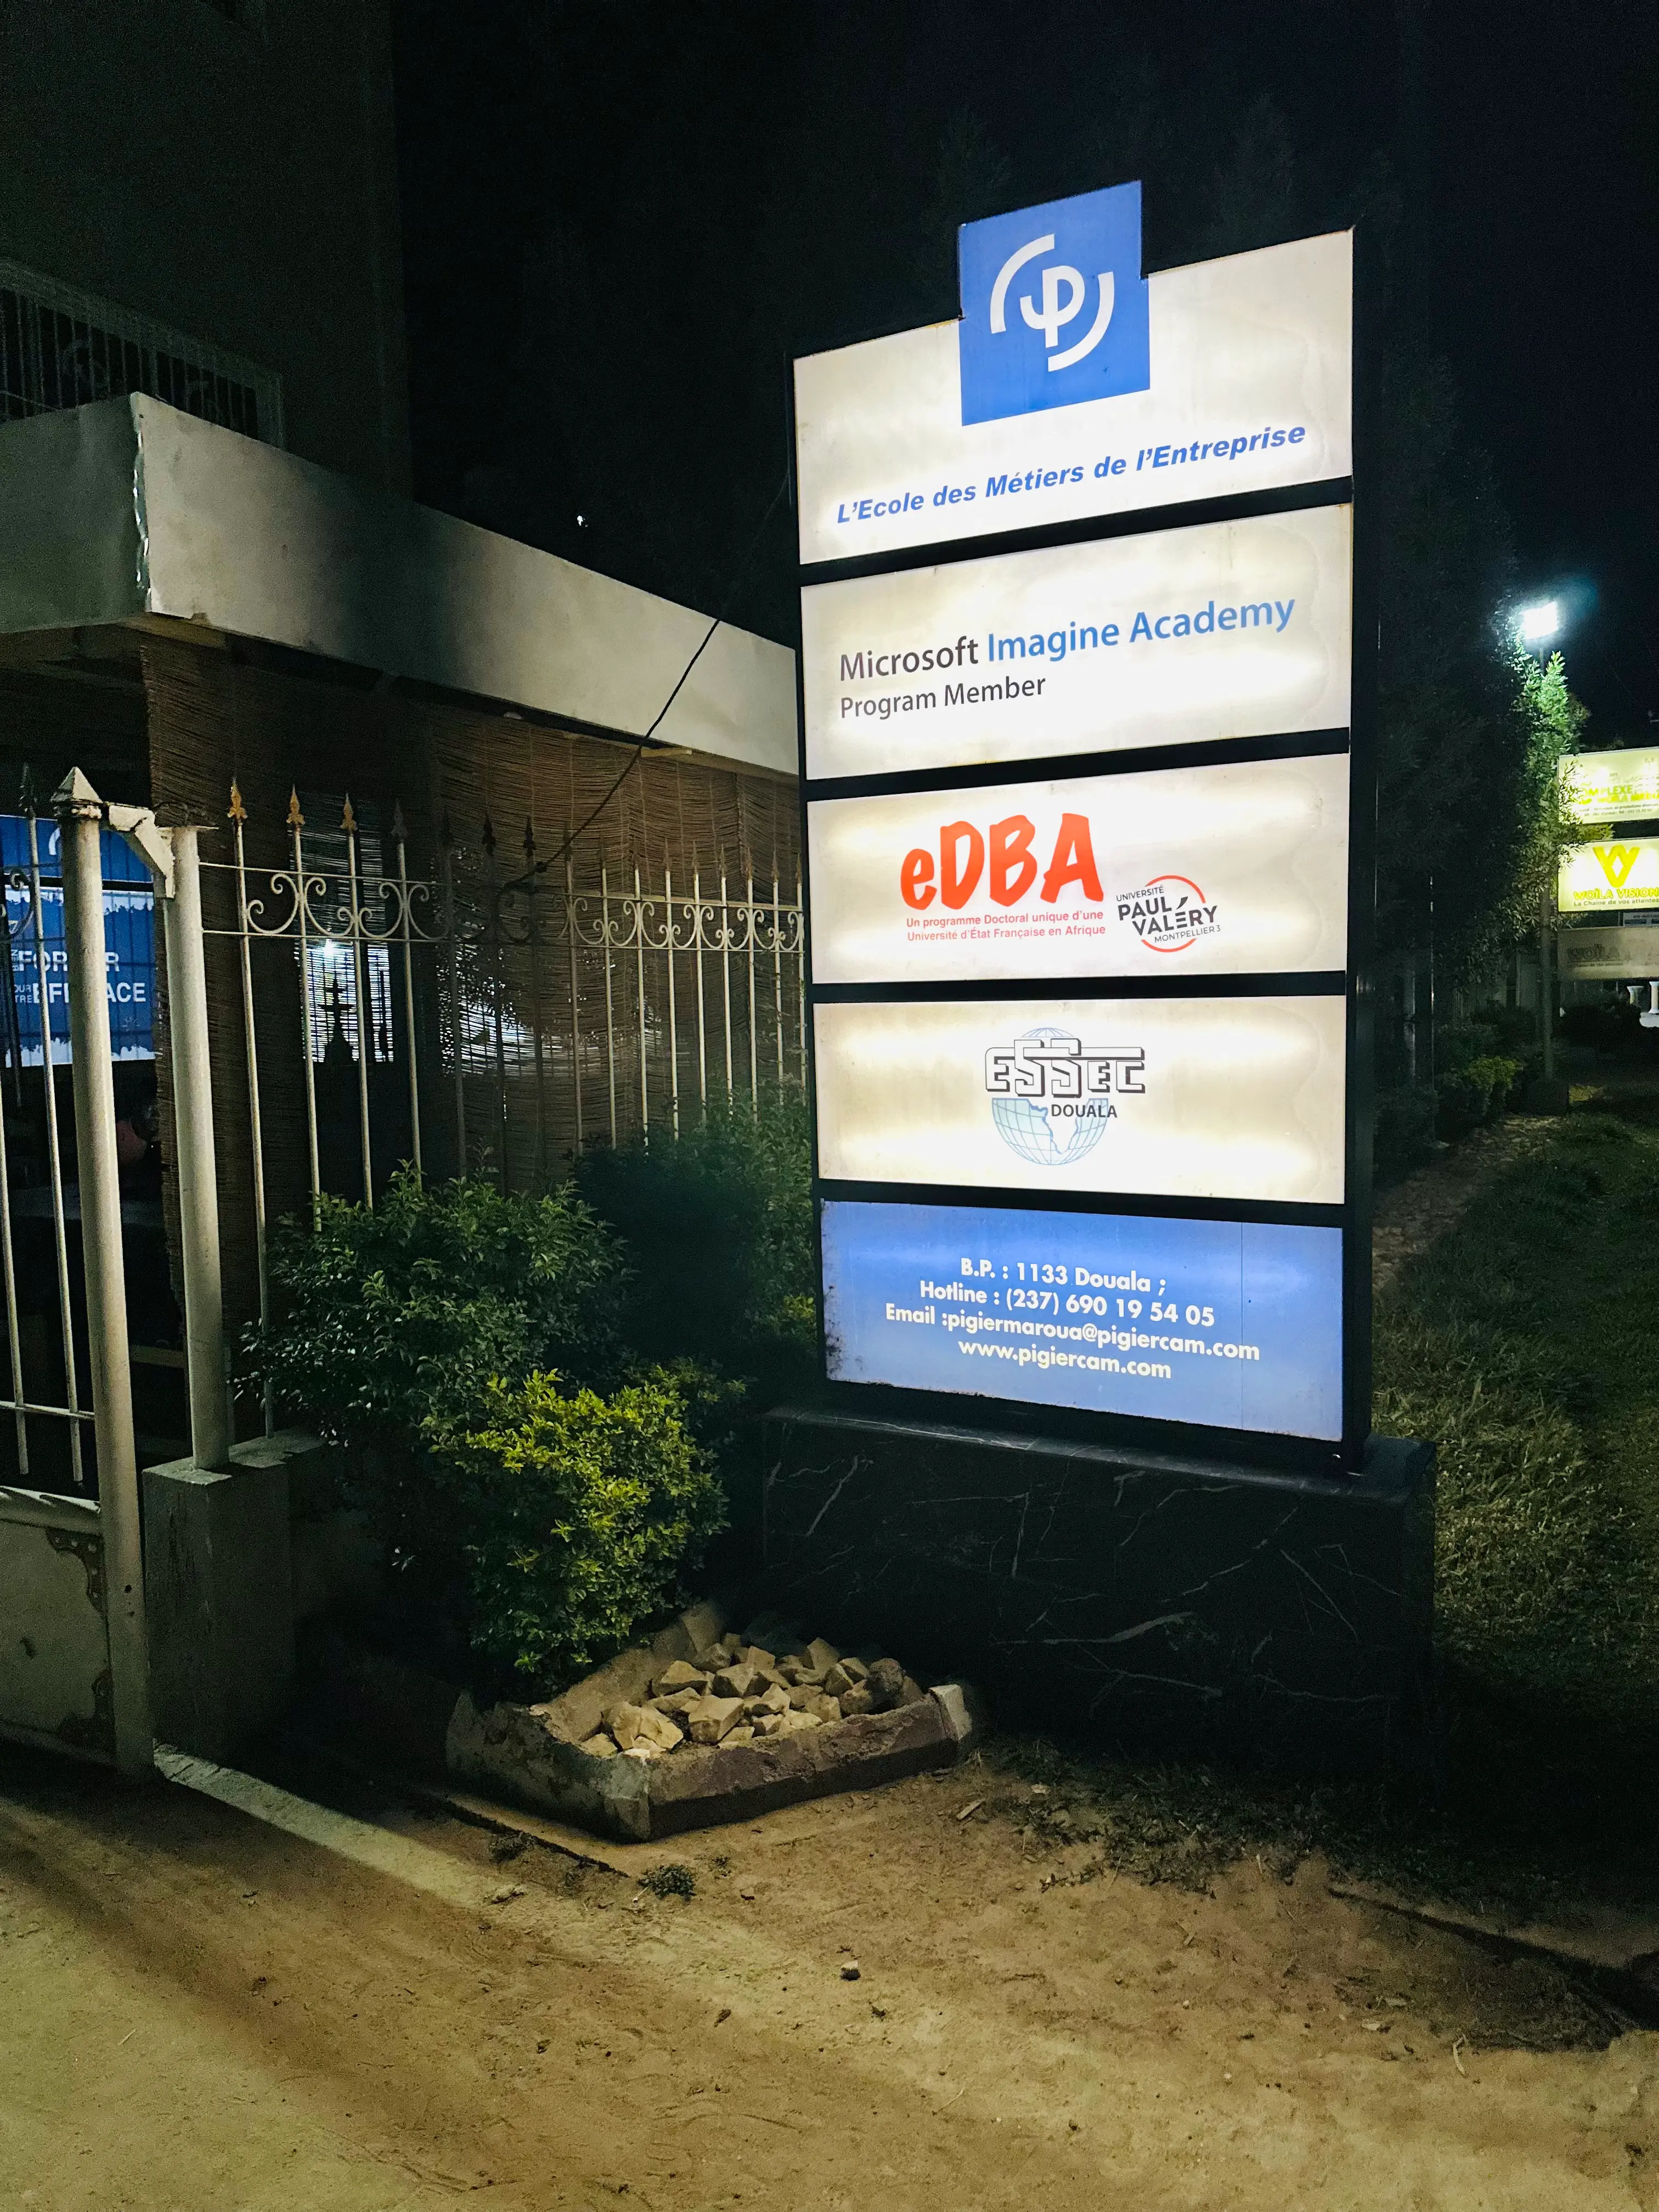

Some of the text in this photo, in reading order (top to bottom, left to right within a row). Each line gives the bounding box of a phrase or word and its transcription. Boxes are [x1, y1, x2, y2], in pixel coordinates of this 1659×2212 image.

[933, 486, 975, 506] des
[986, 466, 1083, 497] Métiers
[1094, 456, 1126, 478] de
[840, 600, 1295, 681] Microsoft Imagine Academy
[841, 675, 1046, 720] Program Member
[900, 812, 1104, 910] eDBA
[1116, 884, 1165, 902] UNIVERSITÉ
[1573, 887, 1659, 900] WOÏLA VISION
[906, 918, 920, 928] Un
[923, 917, 981, 928] programme
[984, 913, 1029, 924] Doctoral
[1031, 912, 1069, 923] unique
[1118, 896, 1172, 921] PAUL
[1131, 896, 1218, 936] VALÉRY
[907, 929, 958, 941] Université
[994, 927, 1045, 940] Française
[1048, 927, 1062, 936] en
[1064, 926, 1106, 936] Afrique
[1154, 926, 1215, 943] MONTPELLIER
[18, 950, 120, 972] FORR
[985, 1037, 1146, 1098] ESSEC
[1051, 1103, 1118, 1119] DOUALA
[961, 1257, 996, 1278] B.P.
[1017, 1262, 1069, 1285] 1133
[1075, 1267, 1151, 1292] Douala
[886, 1302, 935, 1325] Email
[920, 1280, 988, 1304] Hotline
[1006, 1288, 1059, 1316] (237)
[1065, 1294, 1108, 1316] 690
[1116, 1298, 1143, 1319] 19
[1150, 1302, 1178, 1323] 54
[1186, 1305, 1215, 1327] 05
[957, 1341, 1172, 1379] www.pigiercam.com
